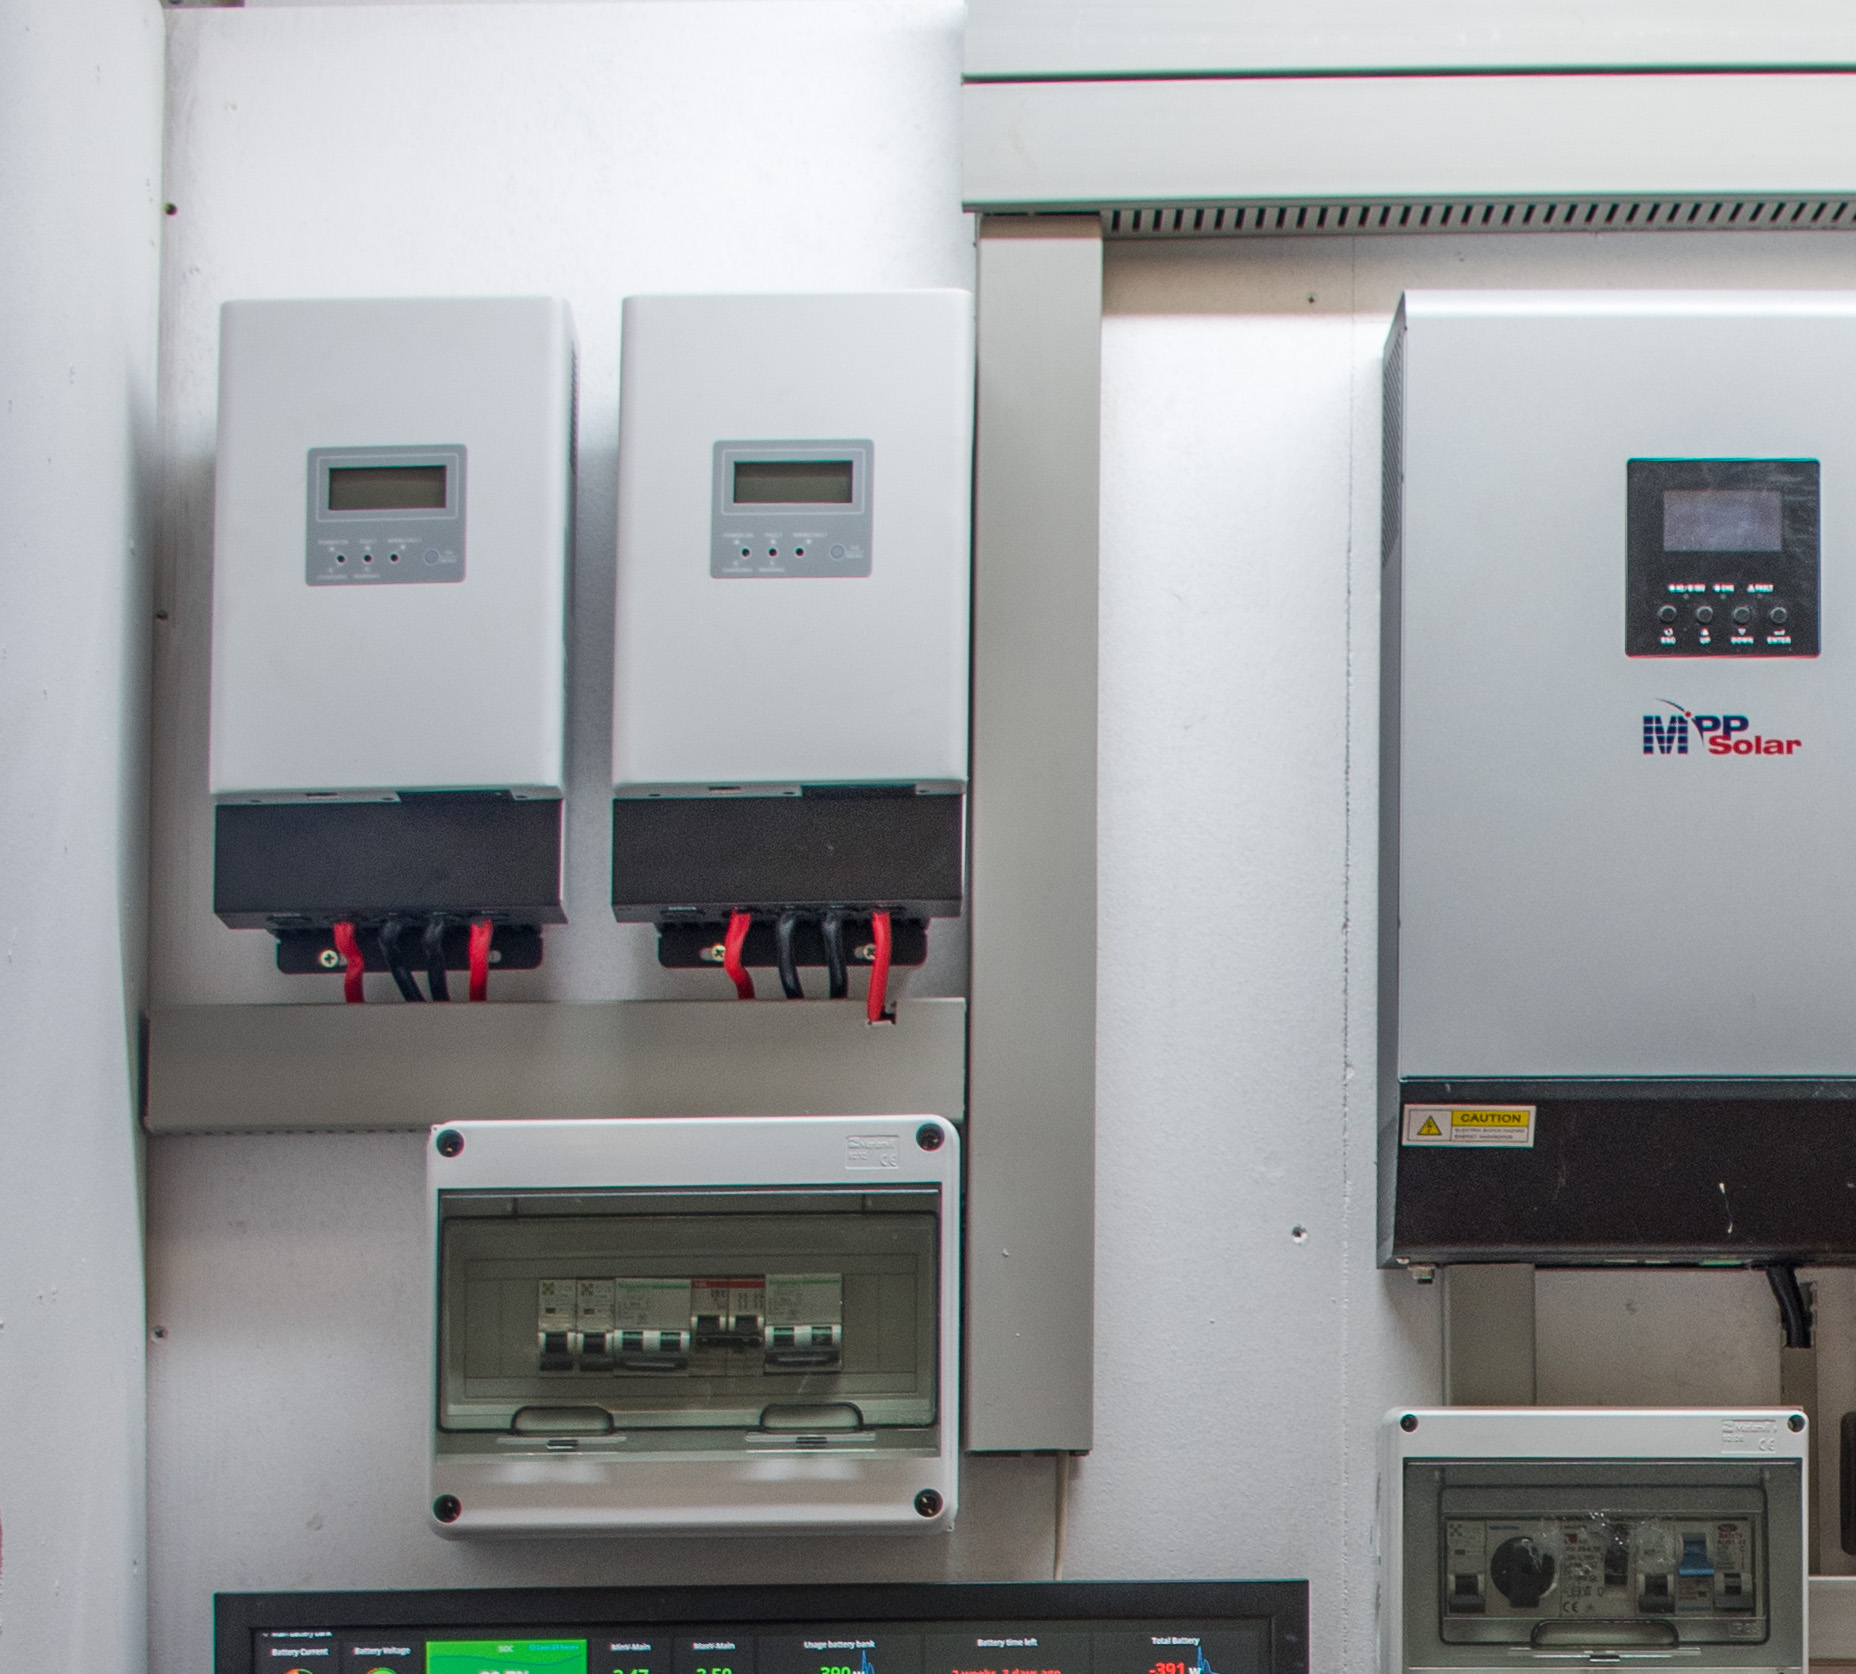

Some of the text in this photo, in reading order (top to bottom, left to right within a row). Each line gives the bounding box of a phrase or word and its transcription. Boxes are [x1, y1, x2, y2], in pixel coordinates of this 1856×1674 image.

[1709, 735, 1802, 755] Solar
[1460, 1113, 1522, 1123] CAUTION
[803, 1640, 876, 1650] Usage battery bank
[977, 1637, 1038, 1648] Battery time left
[1151, 1637, 1200, 1647] Total Battery
[271, 1648, 329, 1657] Battery Current
[353, 1646, 411, 1656] Battery Voltage
